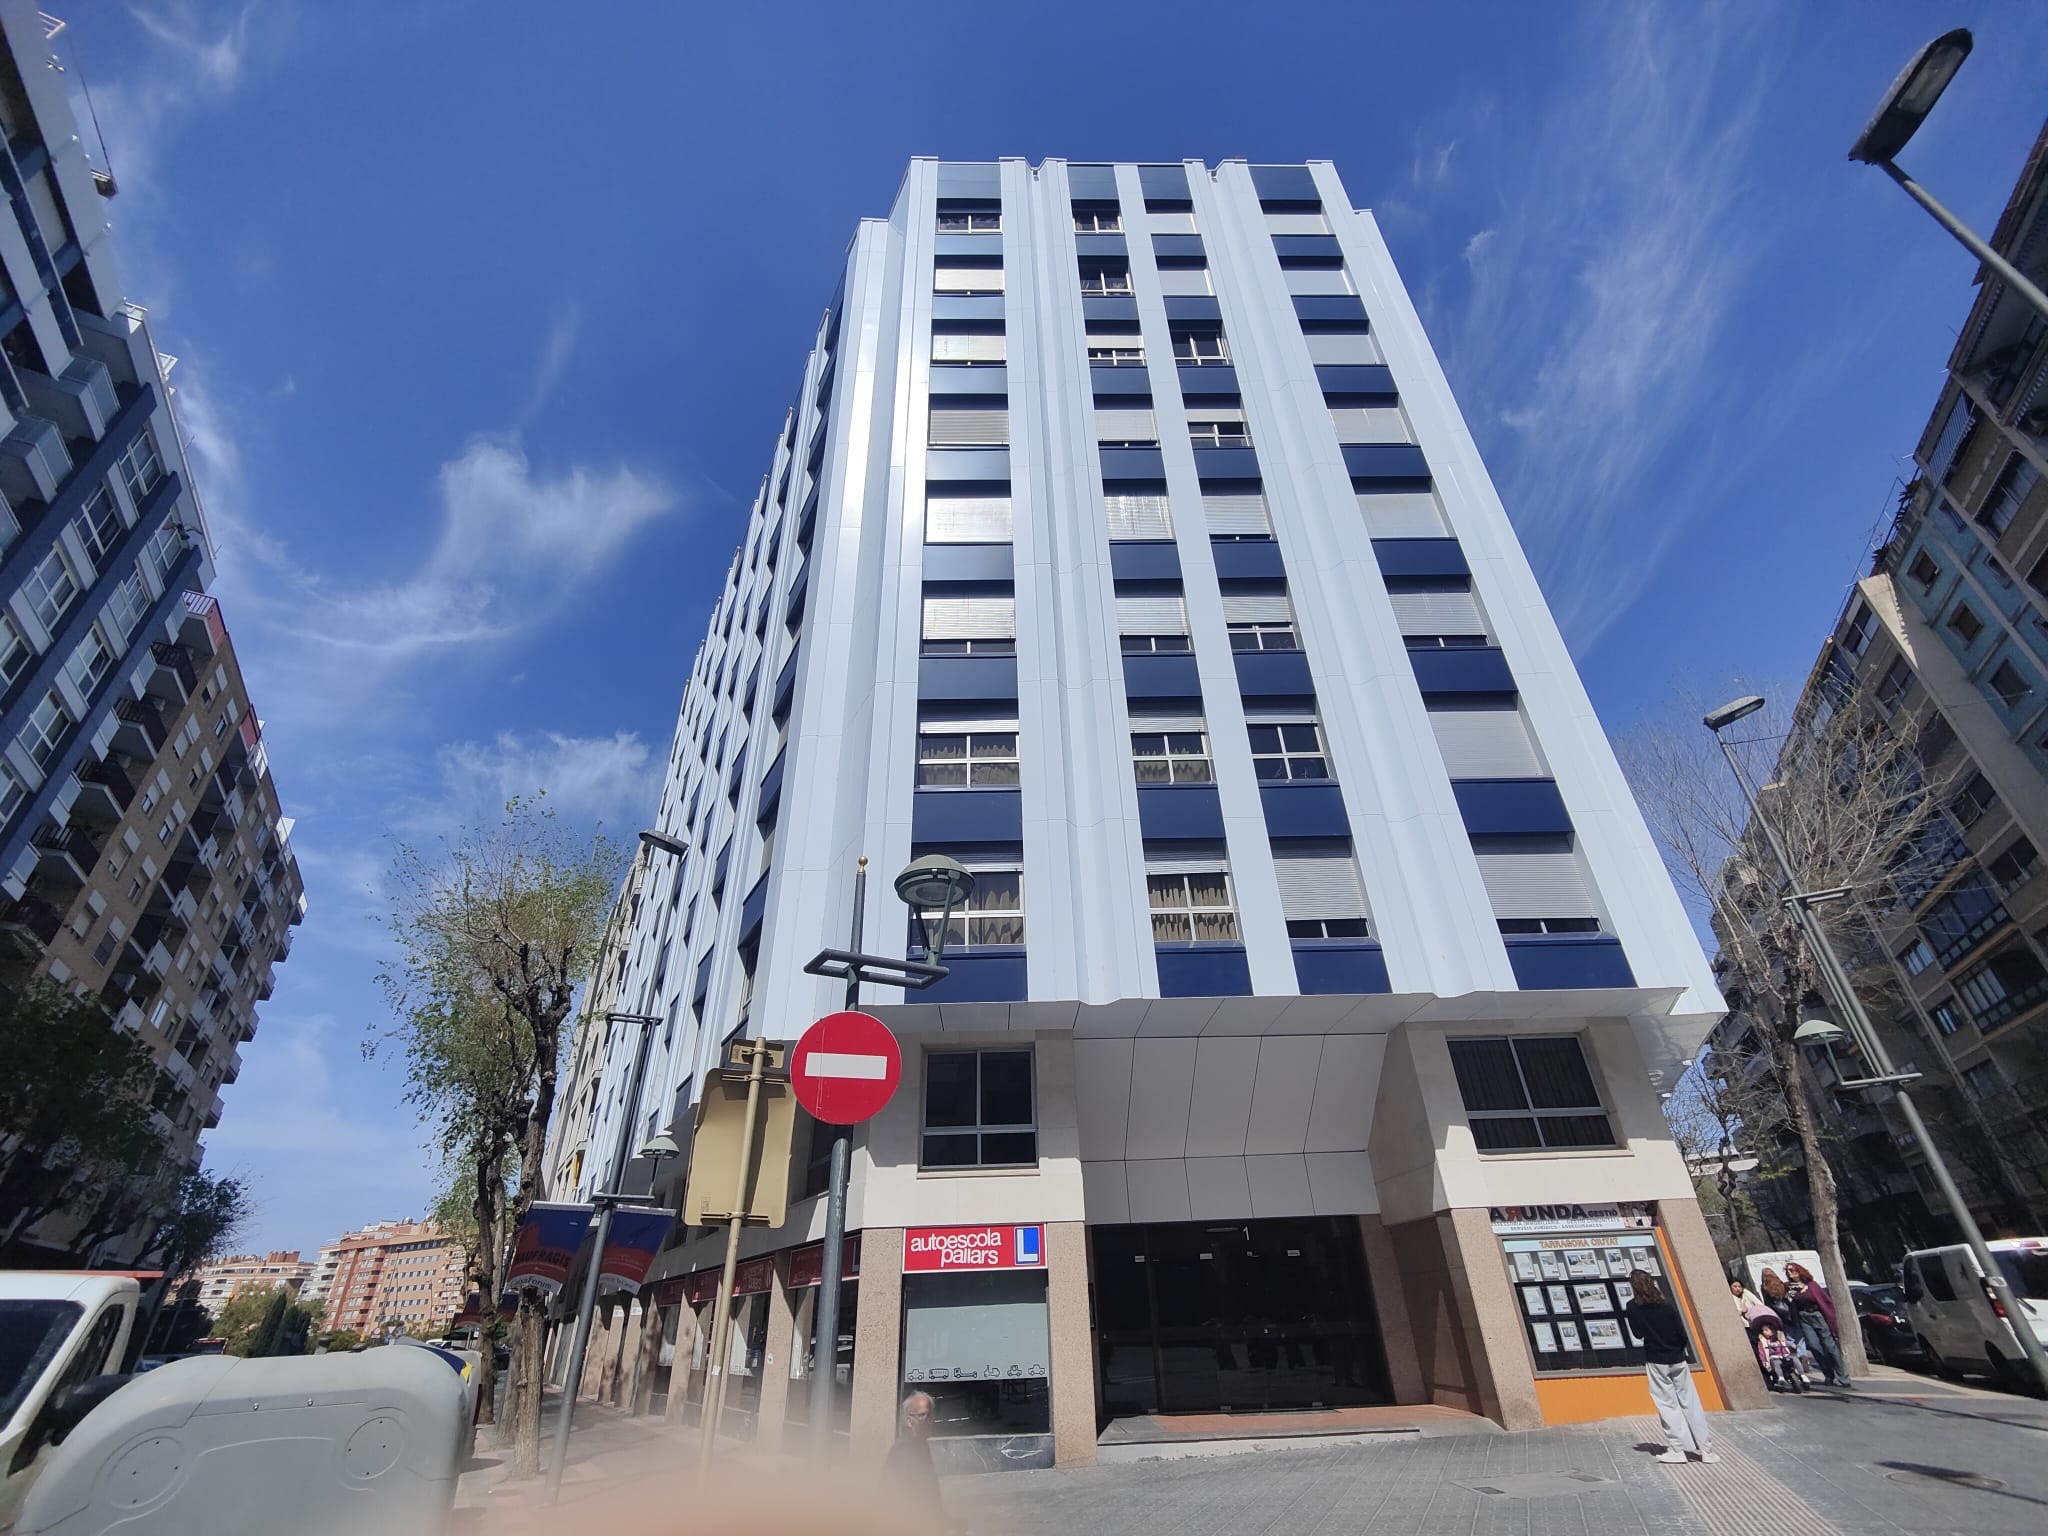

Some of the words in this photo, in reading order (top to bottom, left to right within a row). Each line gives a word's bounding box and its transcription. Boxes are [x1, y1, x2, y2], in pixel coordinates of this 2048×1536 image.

[910, 1228, 1002, 1252] autoescola
[1242, 1226, 1250, 1241] 1
[940, 1248, 999, 1268] pallars
